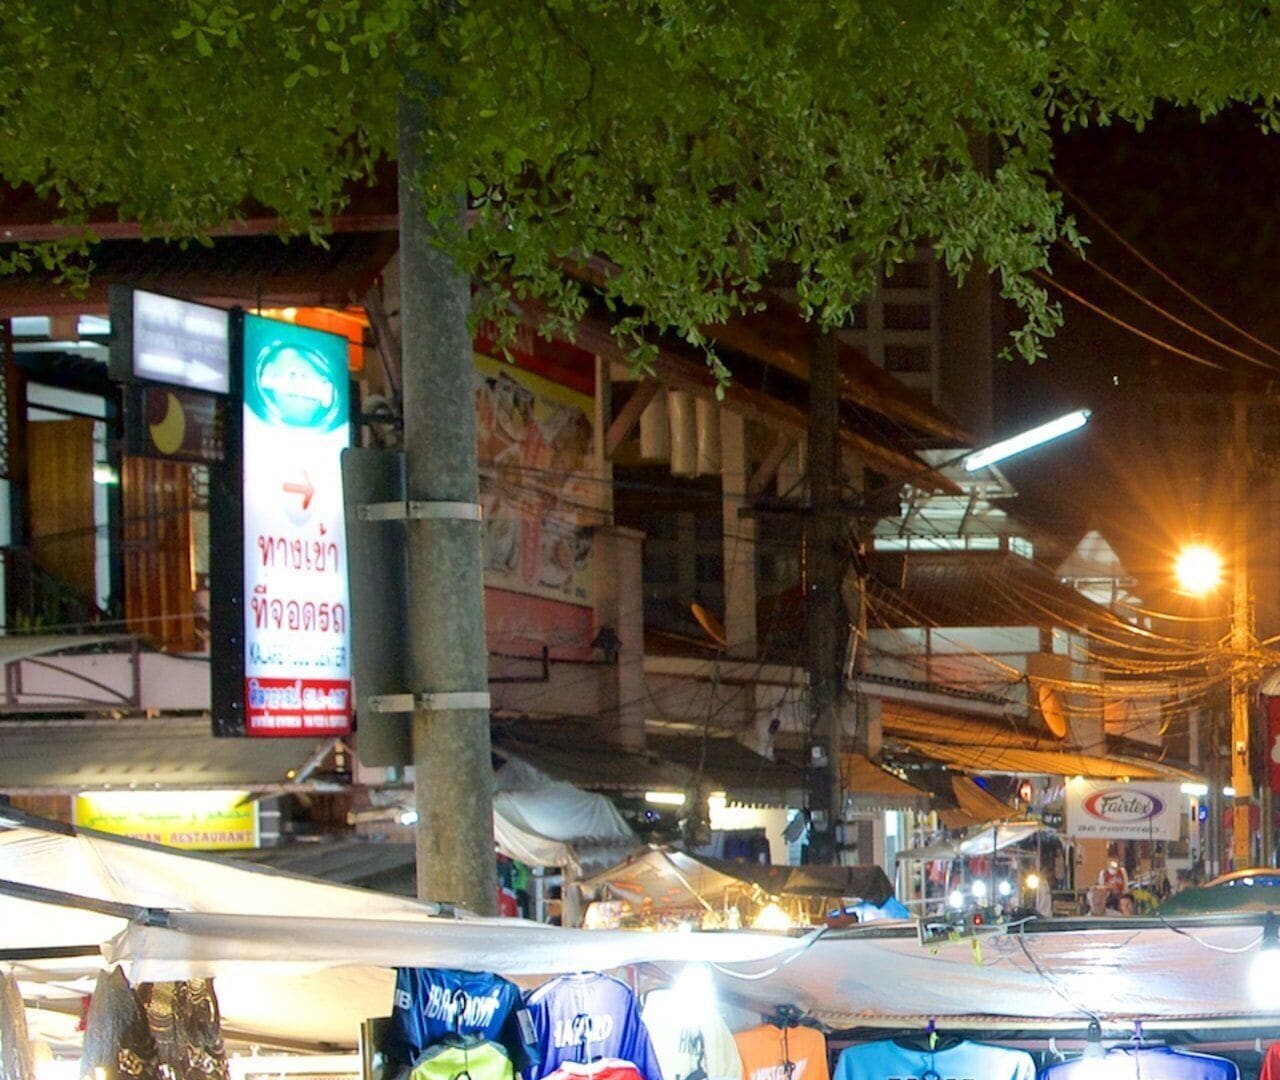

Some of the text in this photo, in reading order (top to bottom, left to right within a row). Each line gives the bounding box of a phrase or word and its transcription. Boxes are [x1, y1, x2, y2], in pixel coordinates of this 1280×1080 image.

[258, 523, 339, 573] ทางเข้า
[1100, 795, 1151, 815] Fairtex
